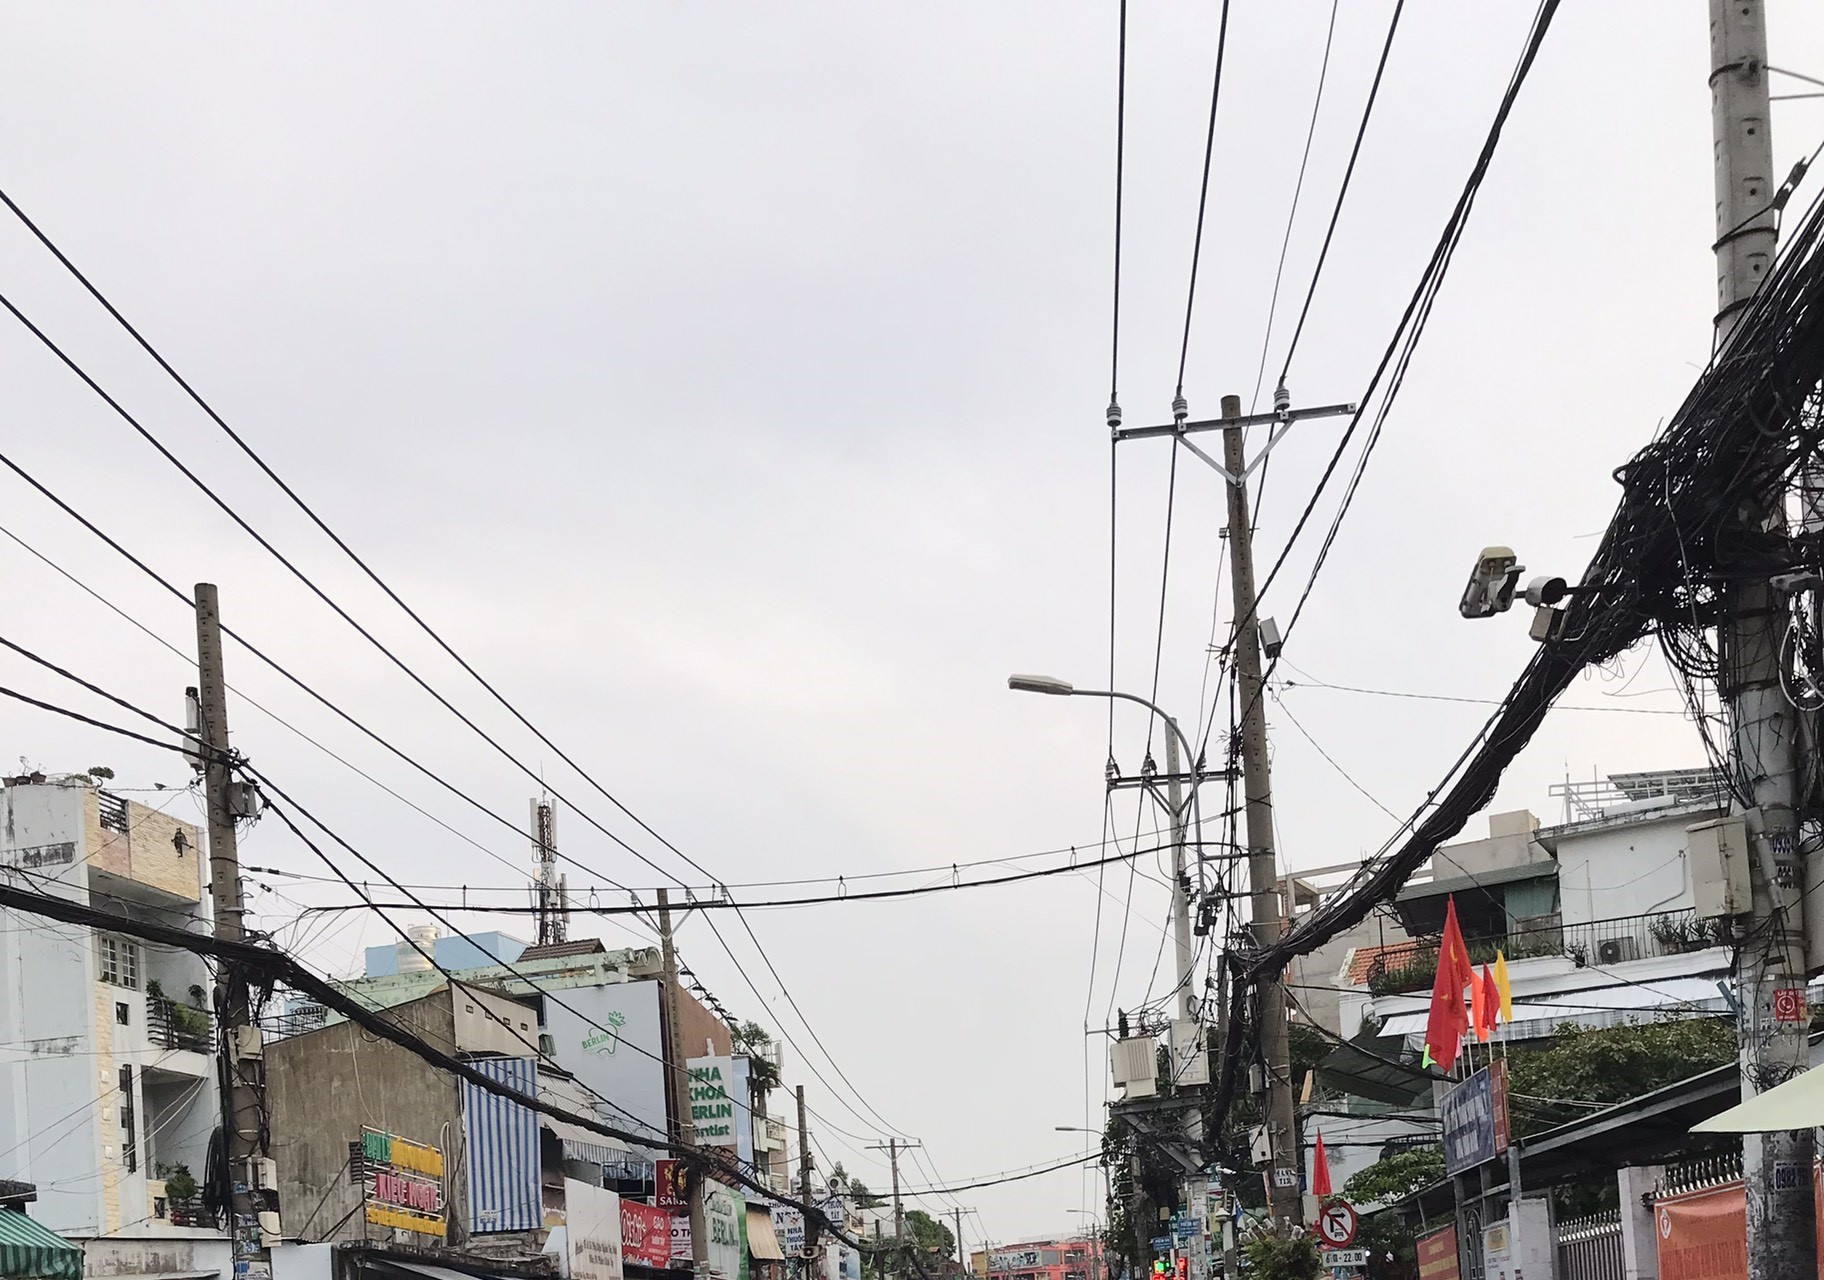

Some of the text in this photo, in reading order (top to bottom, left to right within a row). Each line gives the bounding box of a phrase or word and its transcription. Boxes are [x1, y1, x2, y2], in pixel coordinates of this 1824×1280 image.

[581, 1033, 610, 1049] BERLIN
[688, 1066, 723, 1082] NHA
[691, 1104, 732, 1120] ERLIN
